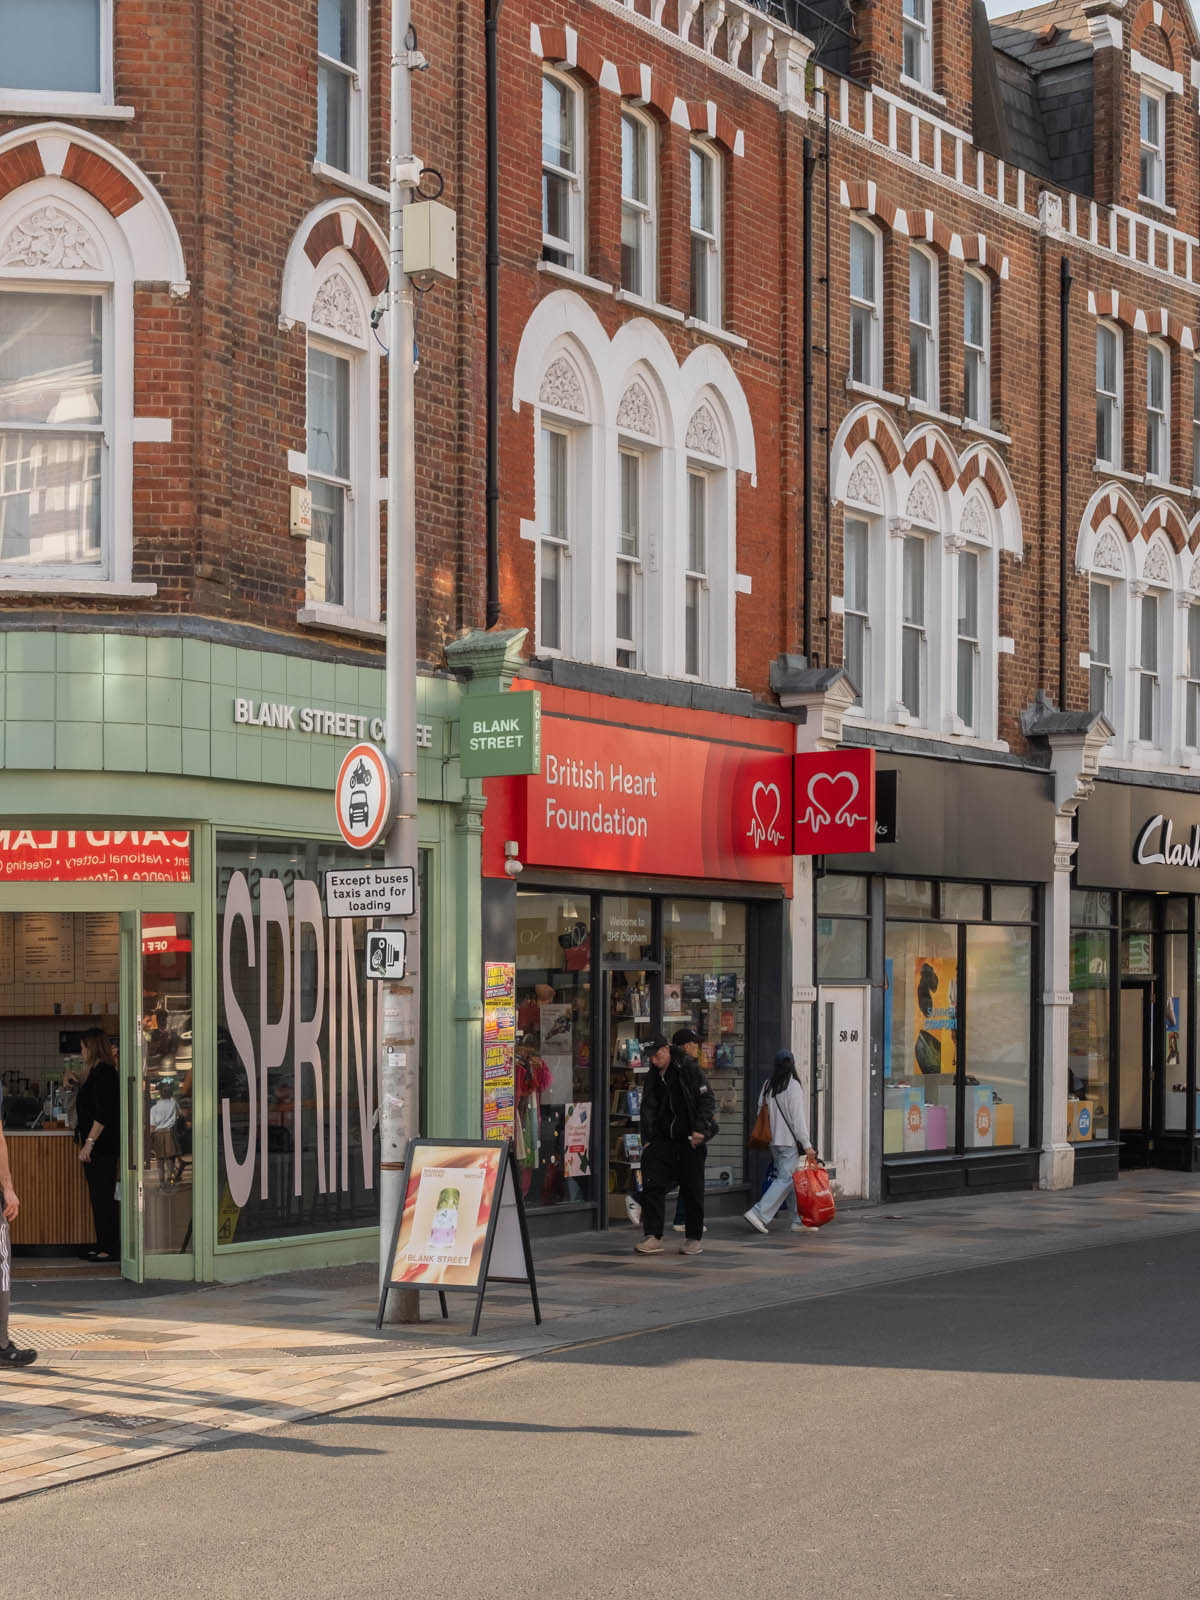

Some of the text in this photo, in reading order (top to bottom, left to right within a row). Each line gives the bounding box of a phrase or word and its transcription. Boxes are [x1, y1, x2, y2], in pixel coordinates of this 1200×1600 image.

[234, 698, 296, 729] BLANK
[300, 708, 368, 739] STREET
[472, 718, 520, 734] BLANK
[469, 735, 524, 751] STREET
[546, 754, 658, 797] British Heart
[545, 798, 648, 838] Foundation
[331, 874, 409, 887] Except buses
[333, 886, 407, 899] taxis and for
[349, 900, 391, 912] loading
[222, 870, 383, 1208] SPRIN
[839, 1030, 859, 1042] 58 60
[407, 1254, 470, 1265] BLANK STREET
